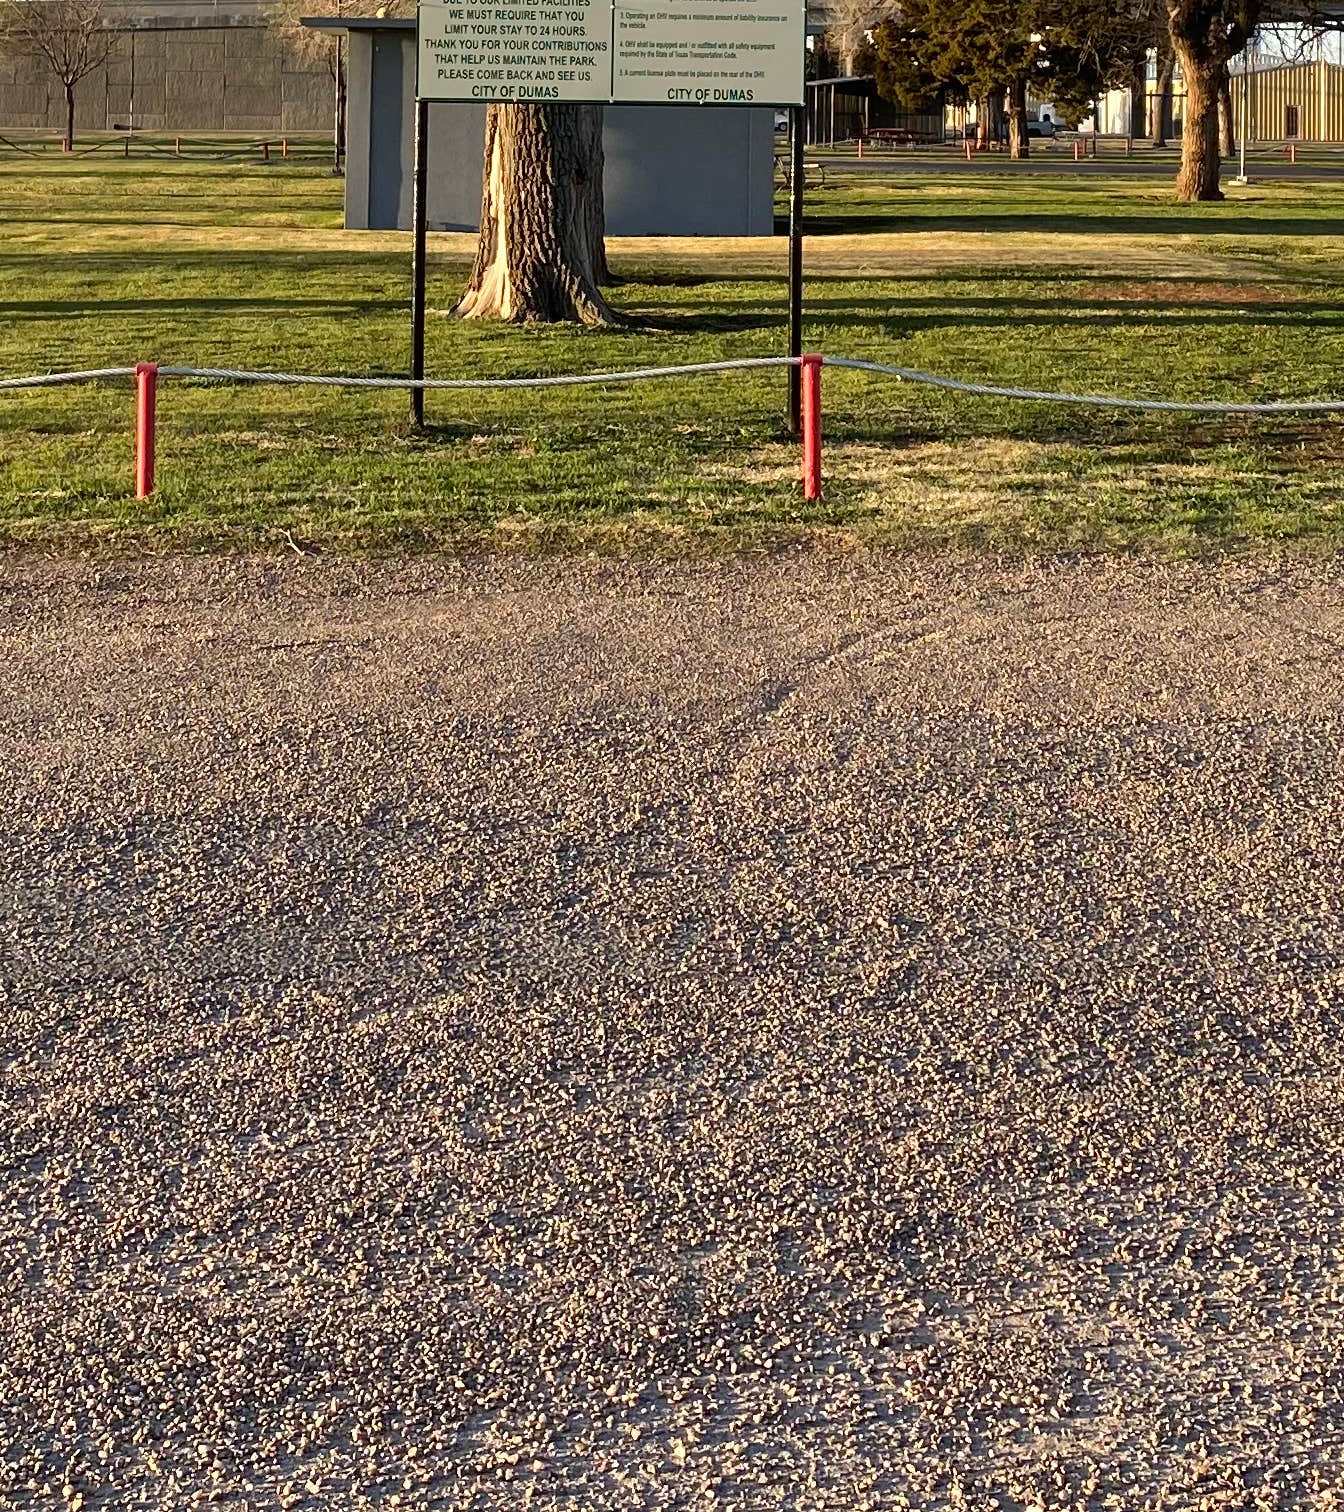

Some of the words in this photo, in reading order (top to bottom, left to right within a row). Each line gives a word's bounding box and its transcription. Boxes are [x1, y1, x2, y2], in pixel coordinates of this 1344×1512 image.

[449, 10, 464, 20] WE
[466, 10, 492, 20] MUST
[494, 10, 536, 20] REQUIRE
[540, 10, 562, 21] THAT
[564, 10, 584, 21] YOU
[444, 24, 468, 35] LIMIT
[470, 24, 497, 35] YOUR
[499, 25, 522, 35] STAY
[525, 25, 537, 36] TO
[539, 26, 550, 36] 24
[424, 39, 456, 50] THANK
[458, 39, 479, 50] YOU
[481, 39, 500, 50] FOR
[503, 40, 529, 50] YOUR
[531, 40, 607, 51] CONTRIBUTIONS
[434, 54, 457, 65] THAT
[460, 54, 485, 65] HELP
[487, 54, 500, 65] US
[502, 55, 546, 66] MAINTAIN
[549, 55, 567, 66] THE
[437, 69, 474, 80] PLEASE
[476, 69, 504, 80] COME
[506, 69, 533, 81] BACK
[534, 69, 555, 81] AND
[557, 69, 575, 81] SEE
[471, 84, 497, 97] CITY
[499, 84, 515, 97] OF
[518, 84, 558, 98] DUMAS
[667, 88, 692, 100] CITY
[694, 88, 710, 100] OF
[713, 88, 753, 100] DUMAS
